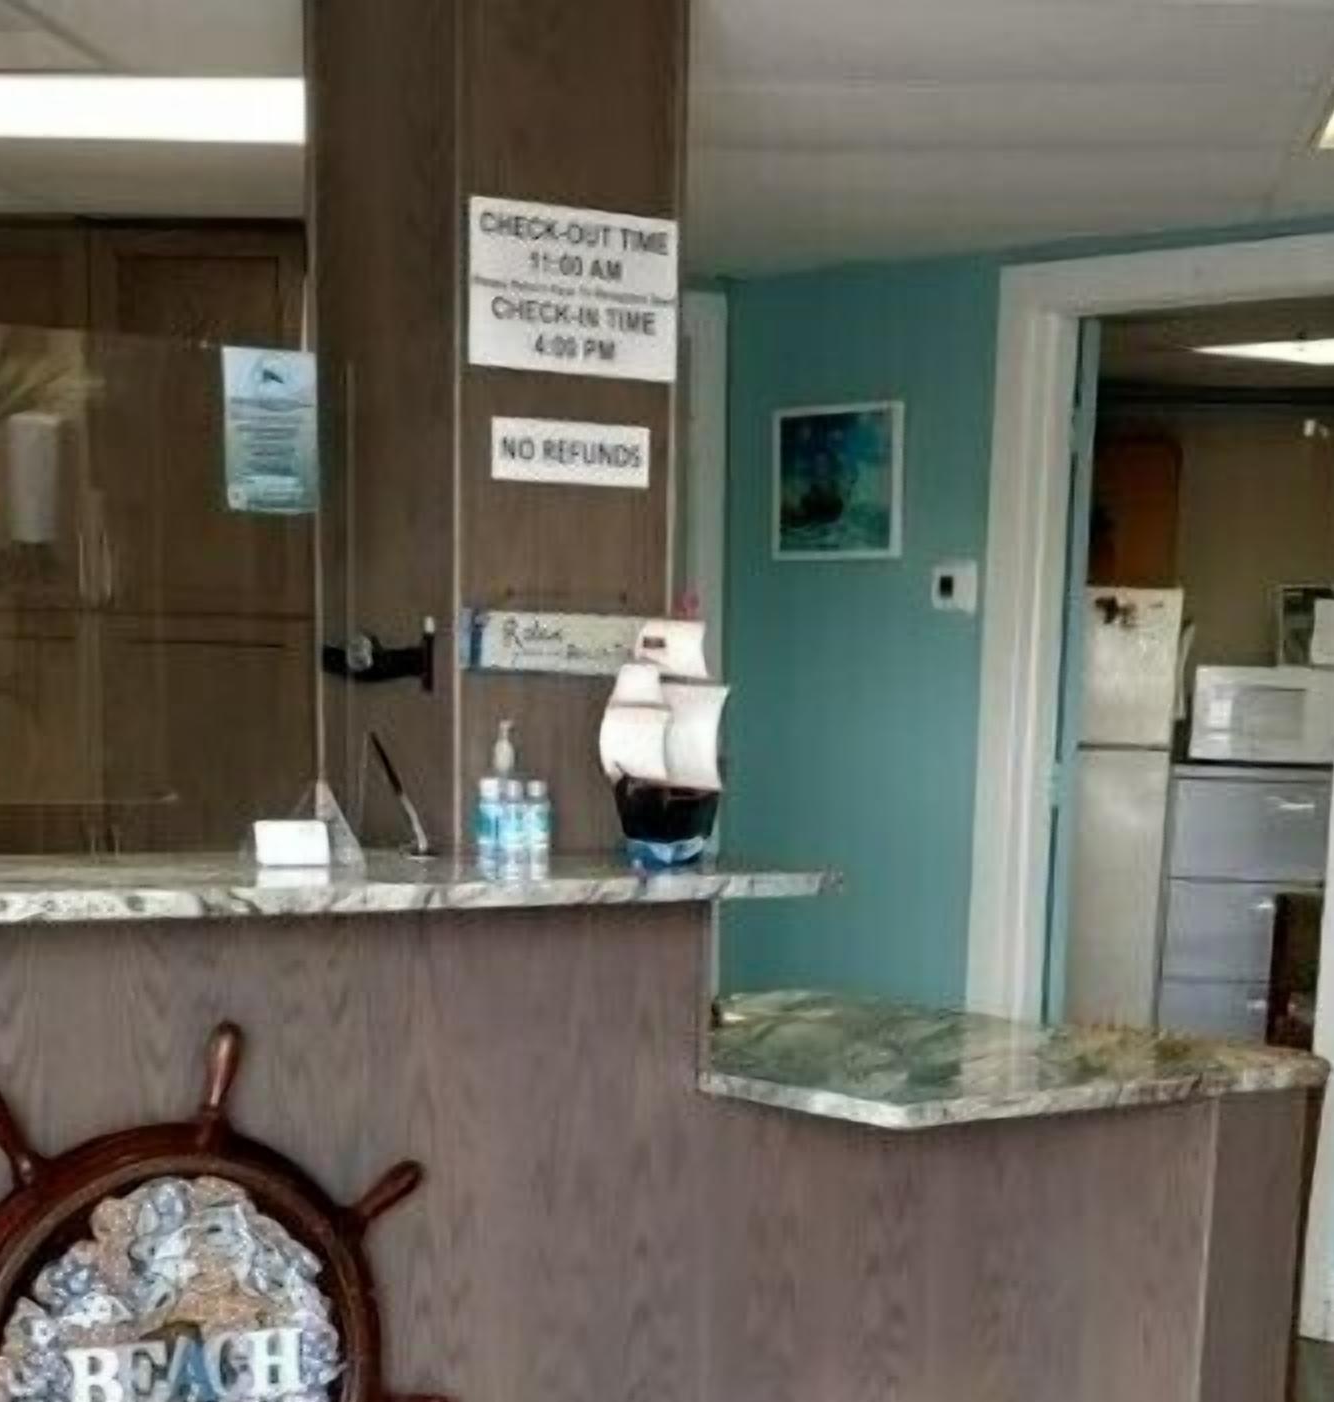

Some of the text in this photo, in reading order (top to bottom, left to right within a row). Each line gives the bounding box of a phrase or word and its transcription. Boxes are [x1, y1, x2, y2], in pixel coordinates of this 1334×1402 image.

[480, 212, 670, 256] CHECK-OUT TIME
[530, 251, 622, 280] 11:00 AM
[491, 296, 657, 336] CHECK-IN TIME
[583, 339, 616, 360] PM
[501, 436, 642, 469] NO REFUNDS
